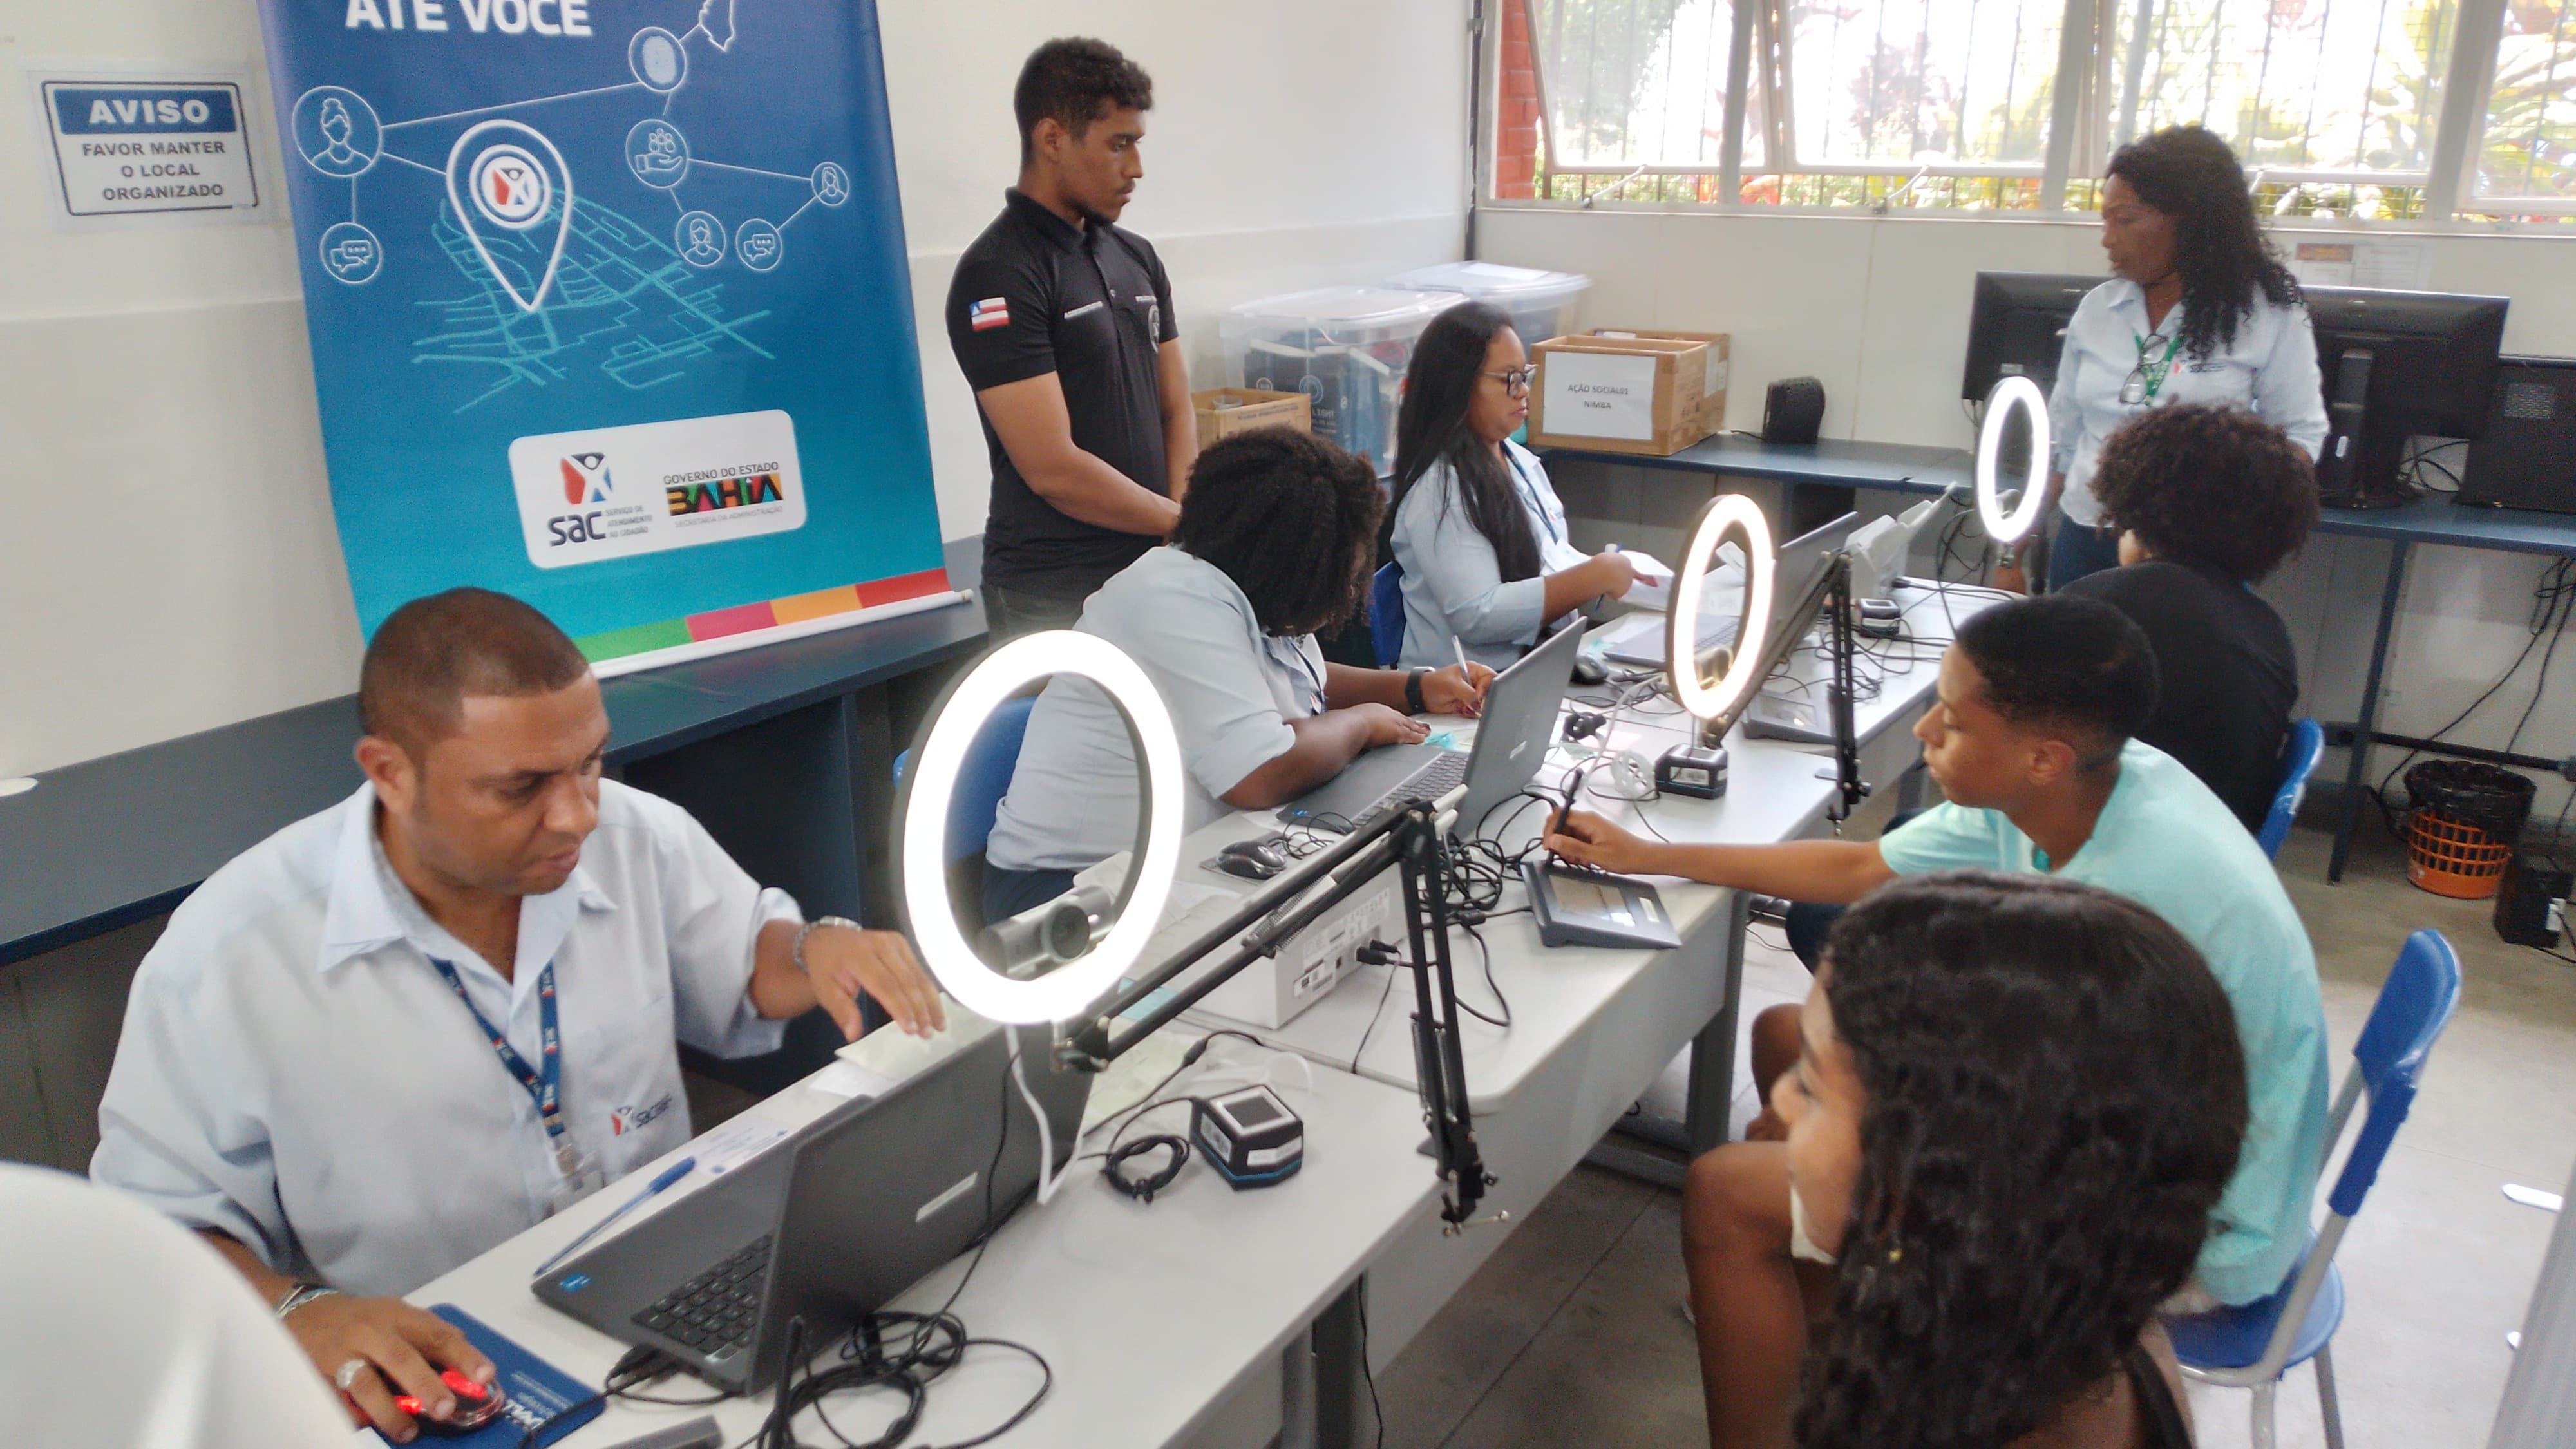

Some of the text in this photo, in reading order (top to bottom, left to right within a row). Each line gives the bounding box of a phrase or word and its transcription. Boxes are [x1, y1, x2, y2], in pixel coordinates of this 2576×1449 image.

[88, 99, 210, 124] AVISO
[82, 140, 225, 157] FAVOR MANTER
[121, 163, 200, 178] O LOCAL
[103, 184, 223, 201] ORGANIZADO
[1567, 383, 1590, 393] AÇÃO
[663, 461, 779, 485] GOVERNO DO ESTADO
